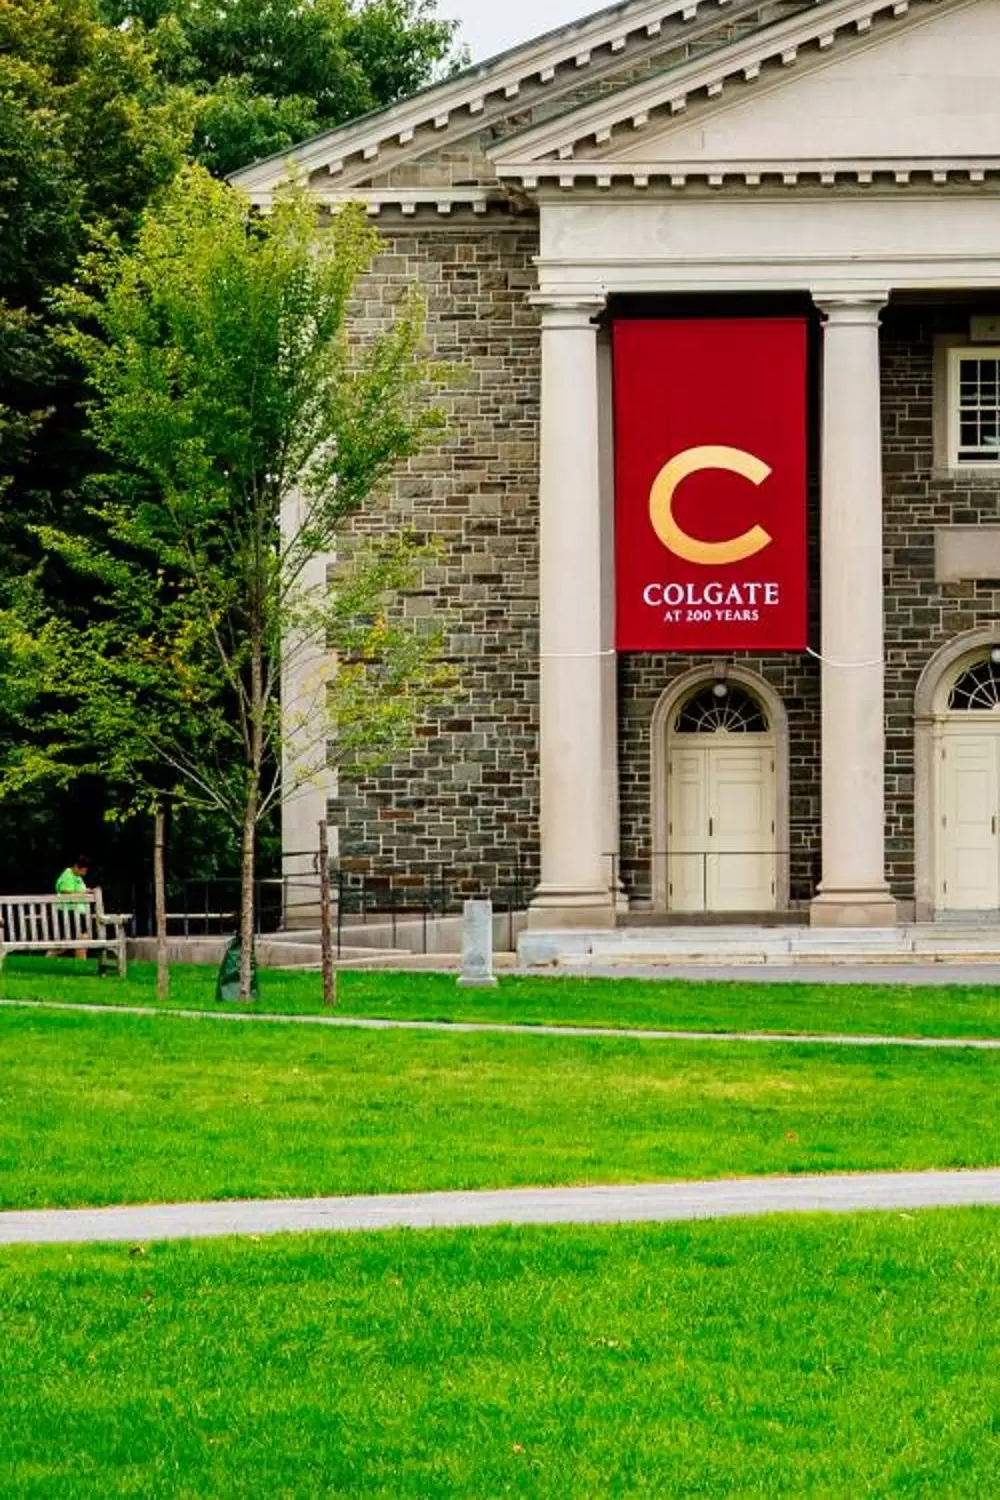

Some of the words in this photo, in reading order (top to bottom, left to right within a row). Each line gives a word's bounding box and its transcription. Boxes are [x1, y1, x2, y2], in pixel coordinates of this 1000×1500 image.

[649, 445, 772, 565] C
[643, 583, 779, 606] COLGATE
[664, 610, 682, 622] AT
[686, 609, 712, 621] 200
[715, 609, 759, 621] YEARS
